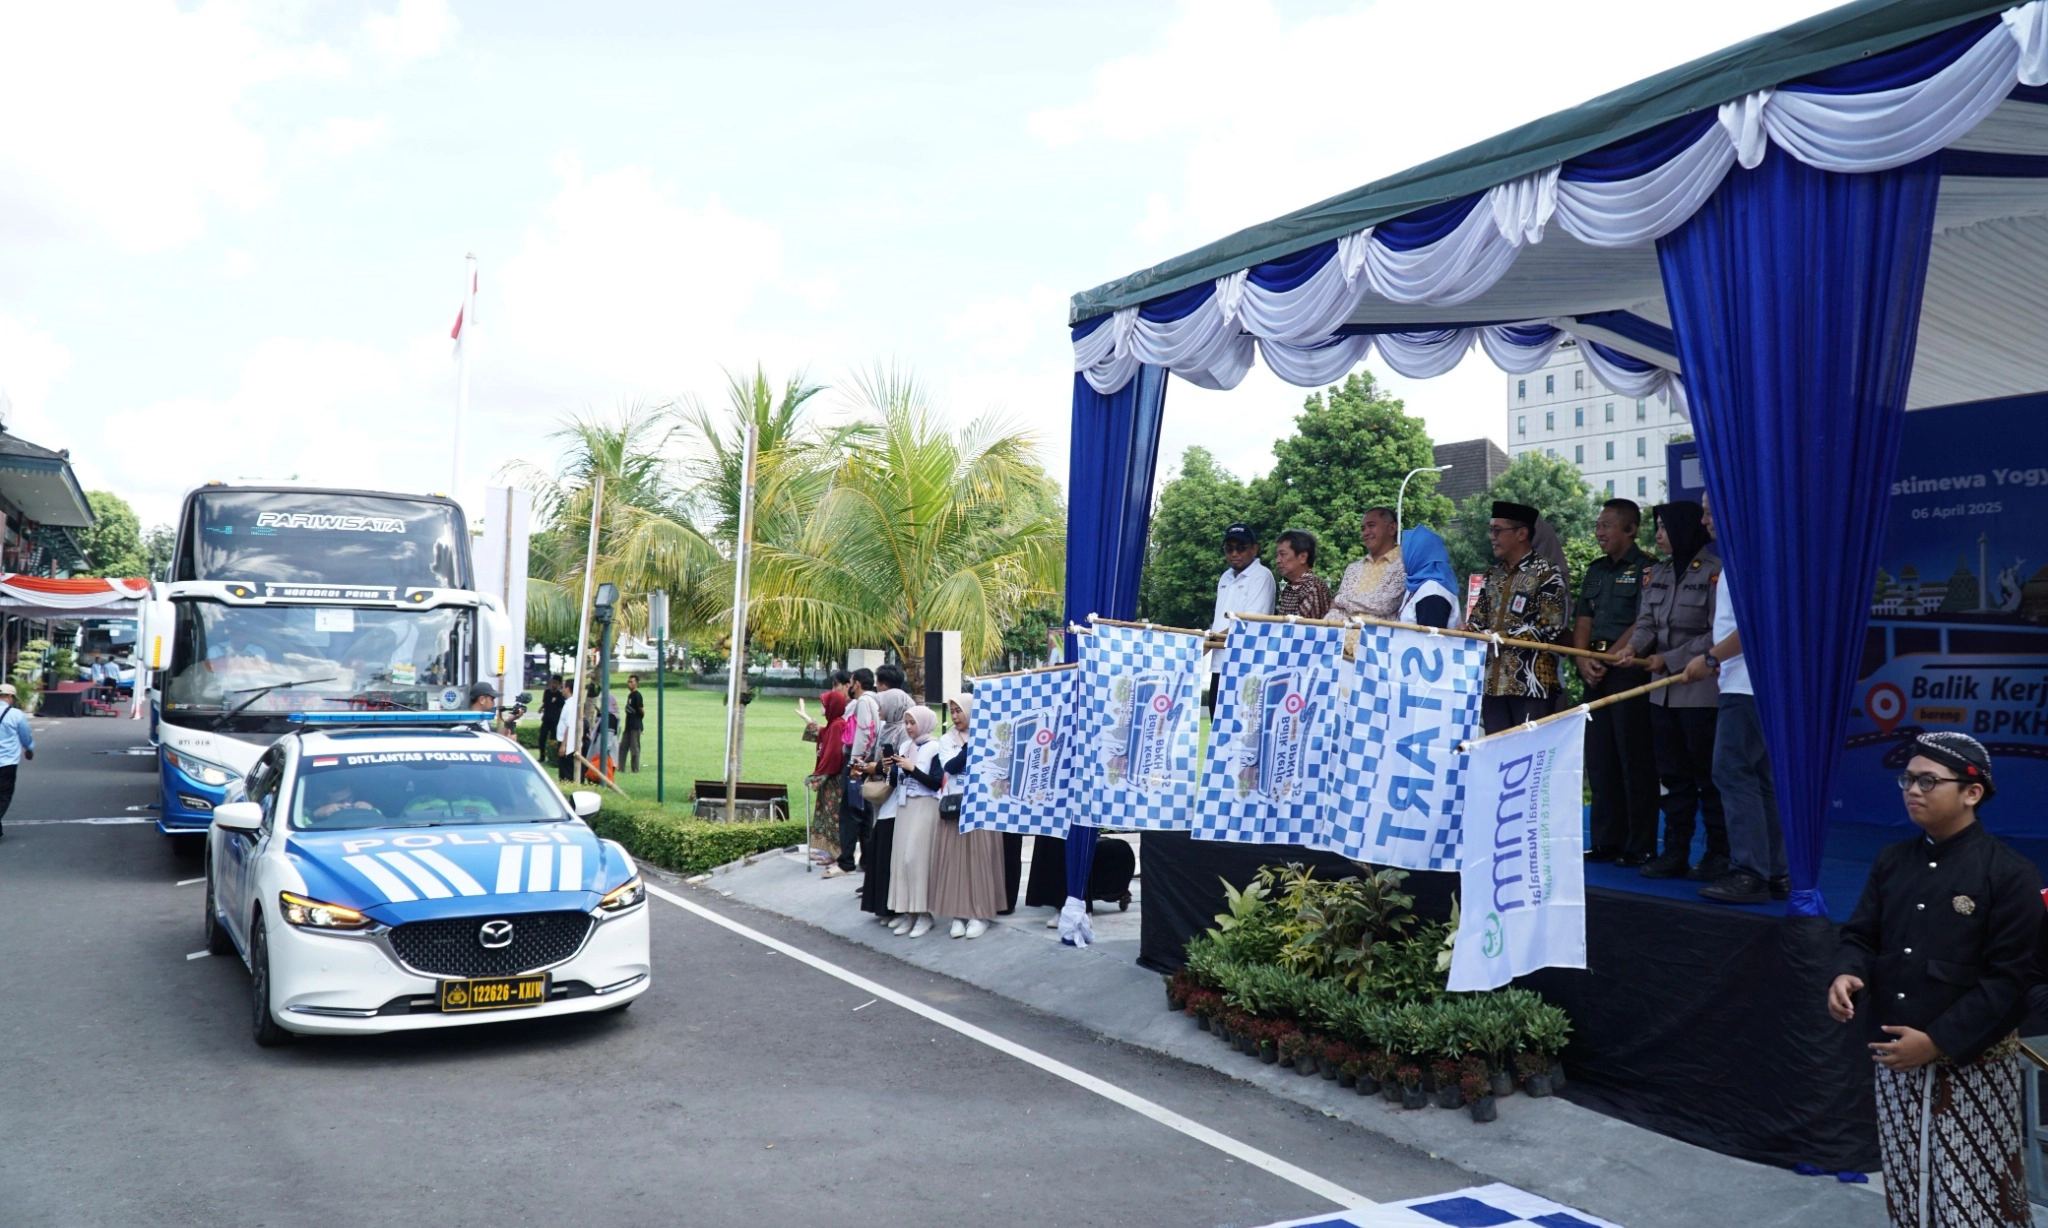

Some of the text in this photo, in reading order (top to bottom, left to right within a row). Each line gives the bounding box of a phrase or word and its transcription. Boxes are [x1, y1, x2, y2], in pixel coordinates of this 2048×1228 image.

[1890, 468, 2048, 496] stimewa Yogy
[1911, 501, 2003, 519] 06 April 2025
[257, 512, 406, 533] PARIWISATA
[1911, 675, 2048, 708] Balik Kerj
[1919, 709, 2048, 736] bareng BPKH
[347, 753, 422, 765] DITLANTAS
[425, 752, 468, 763] POLDA
[469, 752, 492, 763] DIY
[342, 831, 571, 853] POLISI
